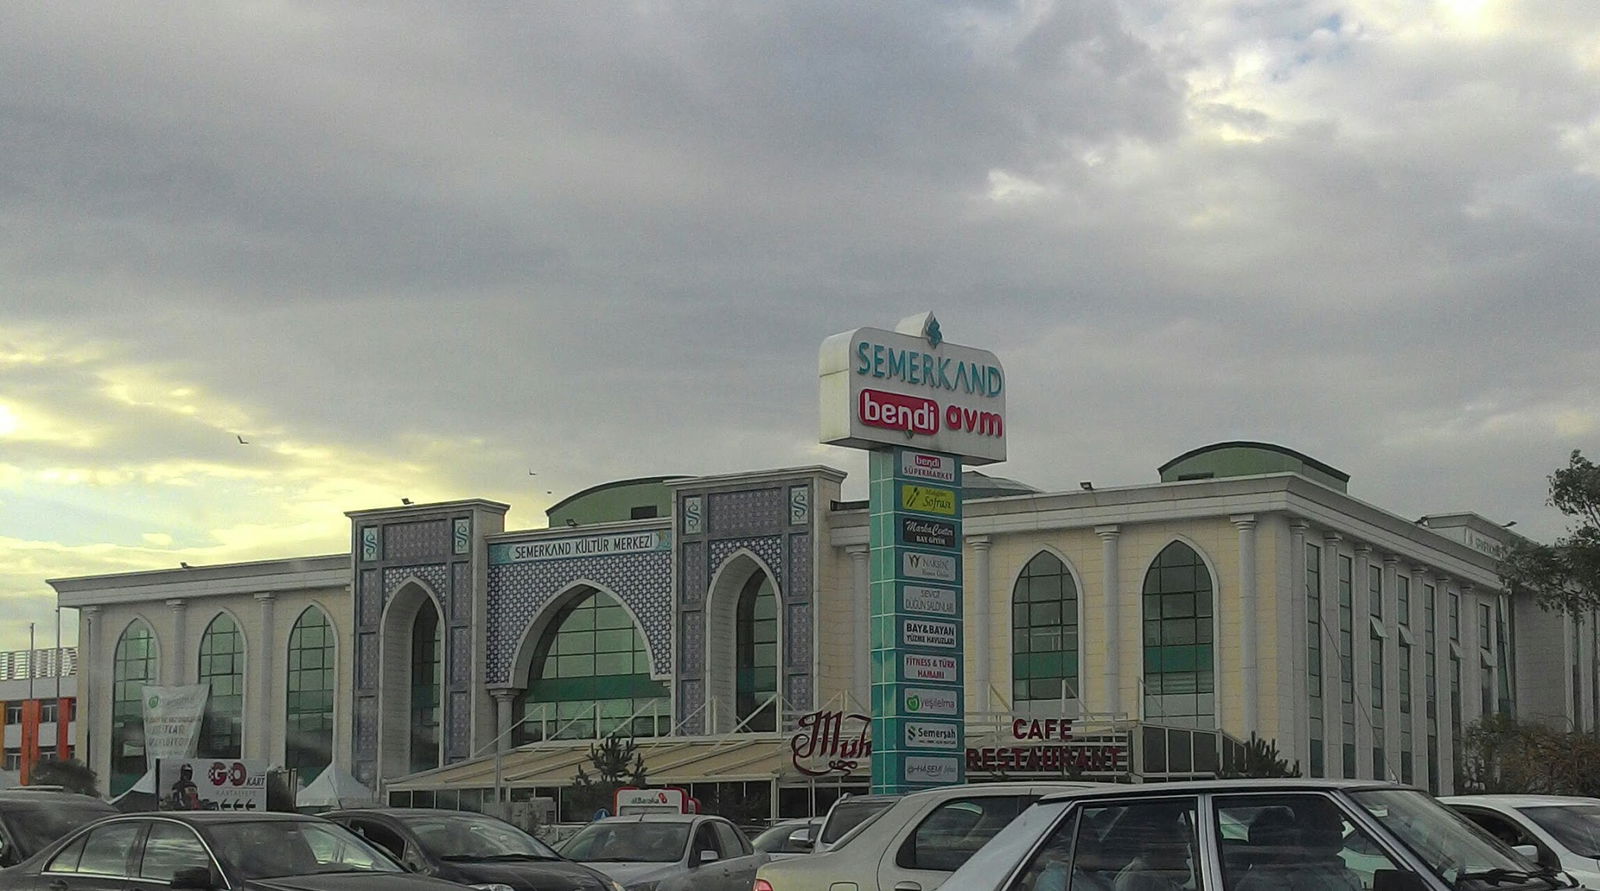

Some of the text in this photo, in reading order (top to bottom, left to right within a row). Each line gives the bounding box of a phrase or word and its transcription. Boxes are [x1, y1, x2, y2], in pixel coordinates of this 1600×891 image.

[857, 342, 1002, 397] SEMERKAND
[864, 392, 1002, 437] bendi avm
[916, 456, 940, 467] bendi
[904, 466, 952, 480] SÜPERMARKET
[515, 542, 571, 559] SEMERKAND
[575, 538, 609, 553] KÜLTÜR
[906, 656, 931, 667] FİTNESS
[939, 657, 955, 669] TÜRK
[1013, 719, 1072, 741] CAFE
[965, 747, 1121, 769] RESTAURANT
[208, 762, 247, 787] GO
